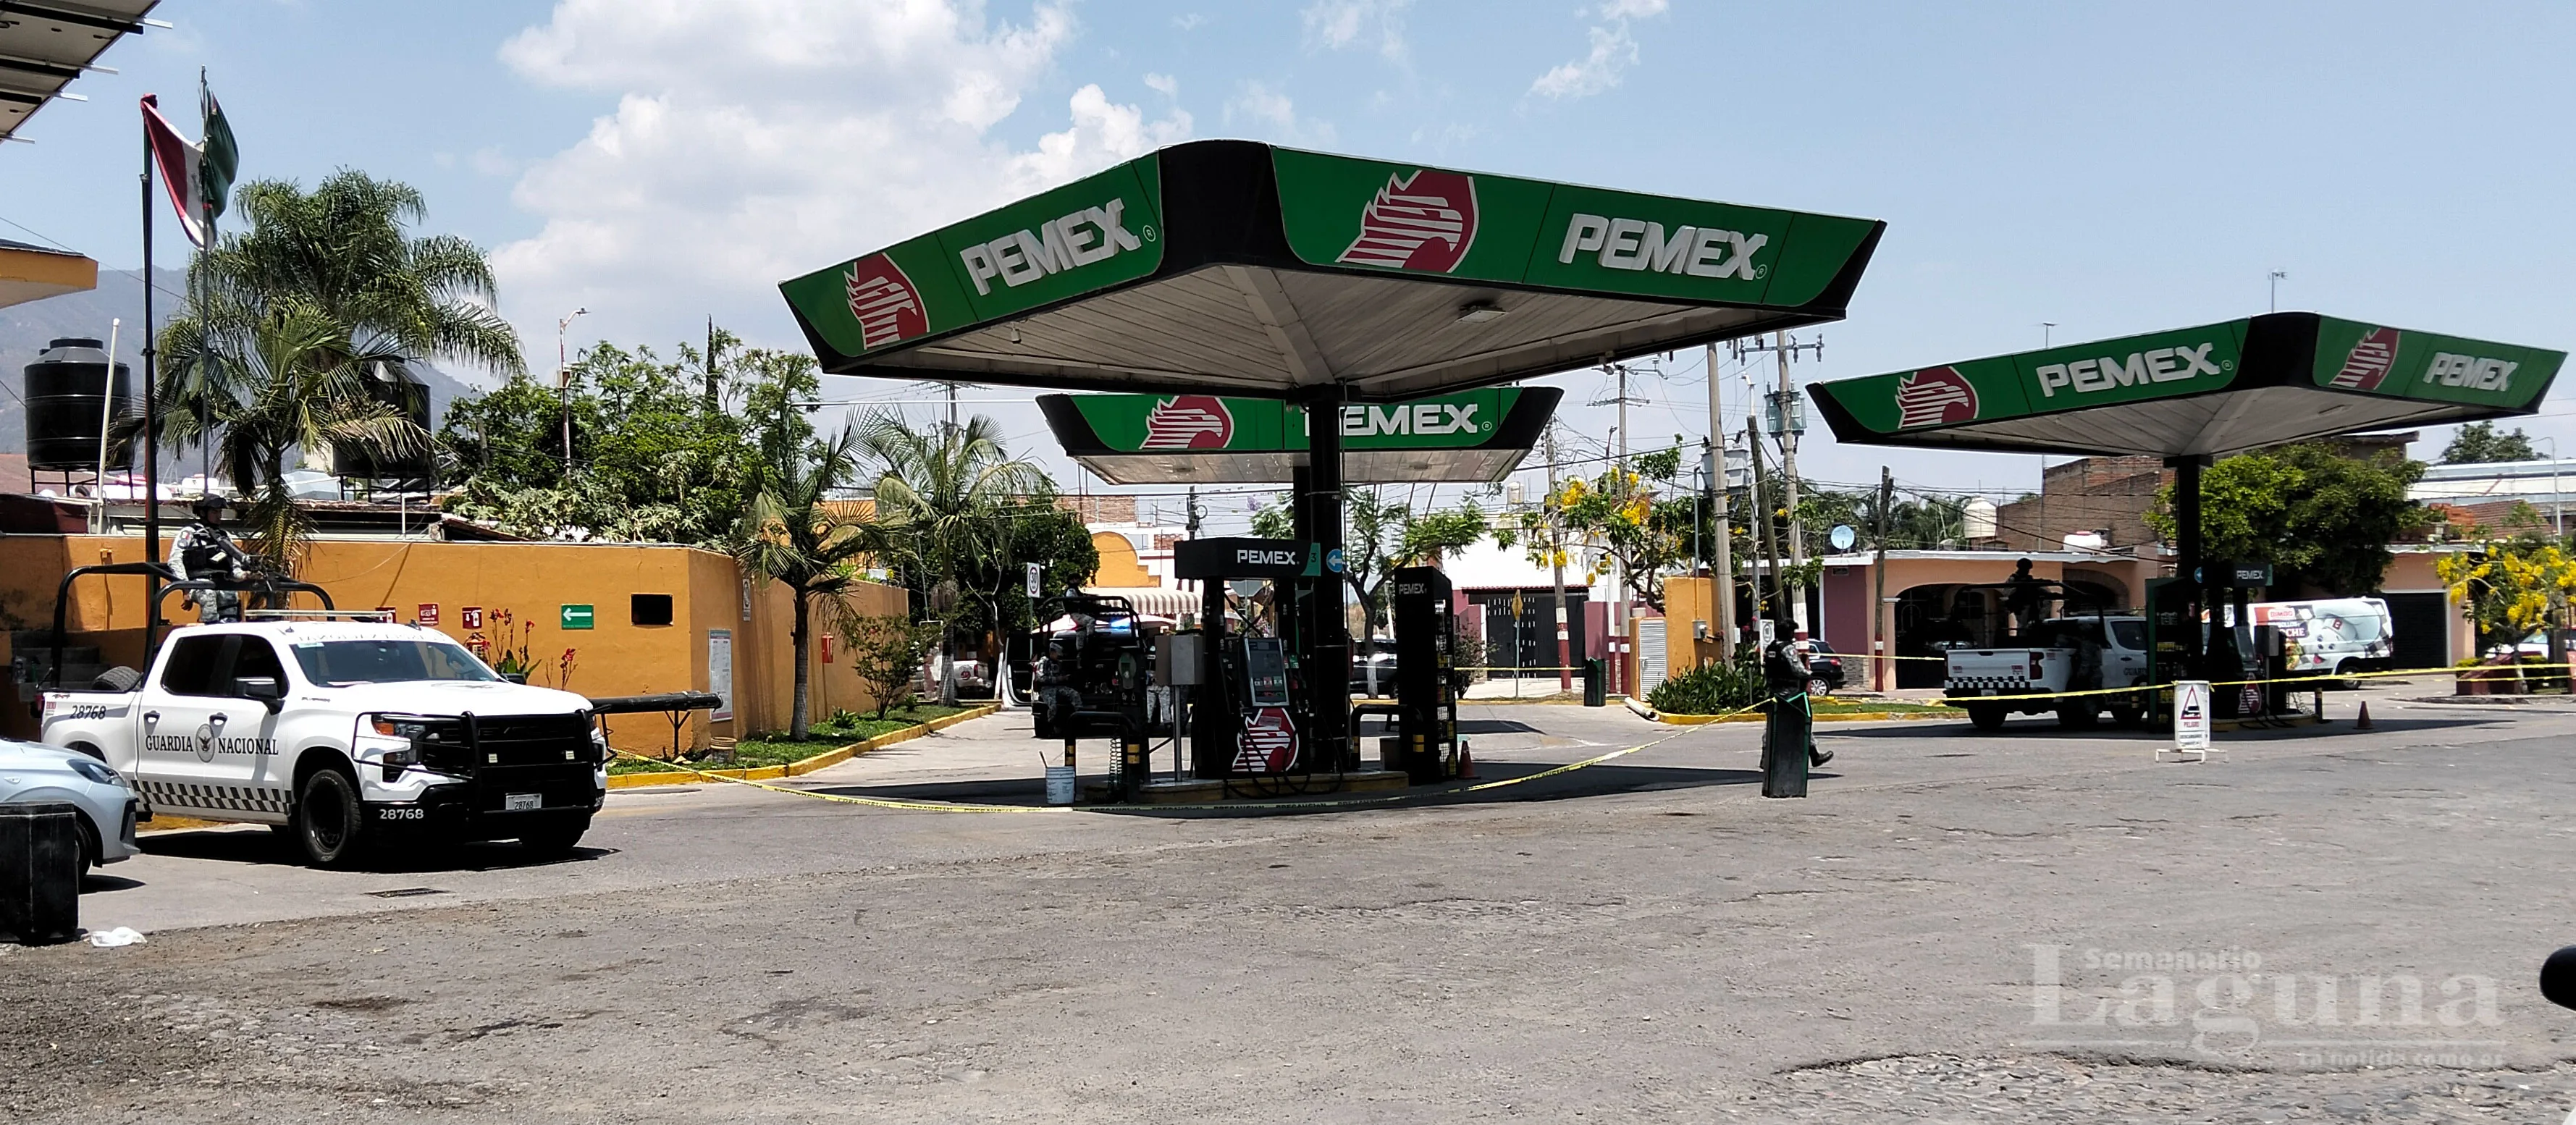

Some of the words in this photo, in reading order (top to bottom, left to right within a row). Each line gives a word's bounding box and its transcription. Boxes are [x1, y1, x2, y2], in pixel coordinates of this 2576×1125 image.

[960, 198, 1142, 296] PEMEX
[1558, 213, 1768, 281] PEMEX
[2037, 342, 2221, 397] PEMEX
[2423, 352, 2520, 392] PEMEX
[1305, 403, 1478, 435] EMEX
[1237, 549, 1296, 565] PEMEX
[1310, 552, 1317, 563] 3
[2236, 570, 2264, 580] PEMEX
[1398, 583, 1425, 595] PEMEX
[69, 704, 107, 720] 28768
[146, 735, 194, 752] GUARDIA
[218, 737, 279, 756] NACIONAL
[515, 800, 534, 810] 28768
[379, 809, 424, 819] 28768
